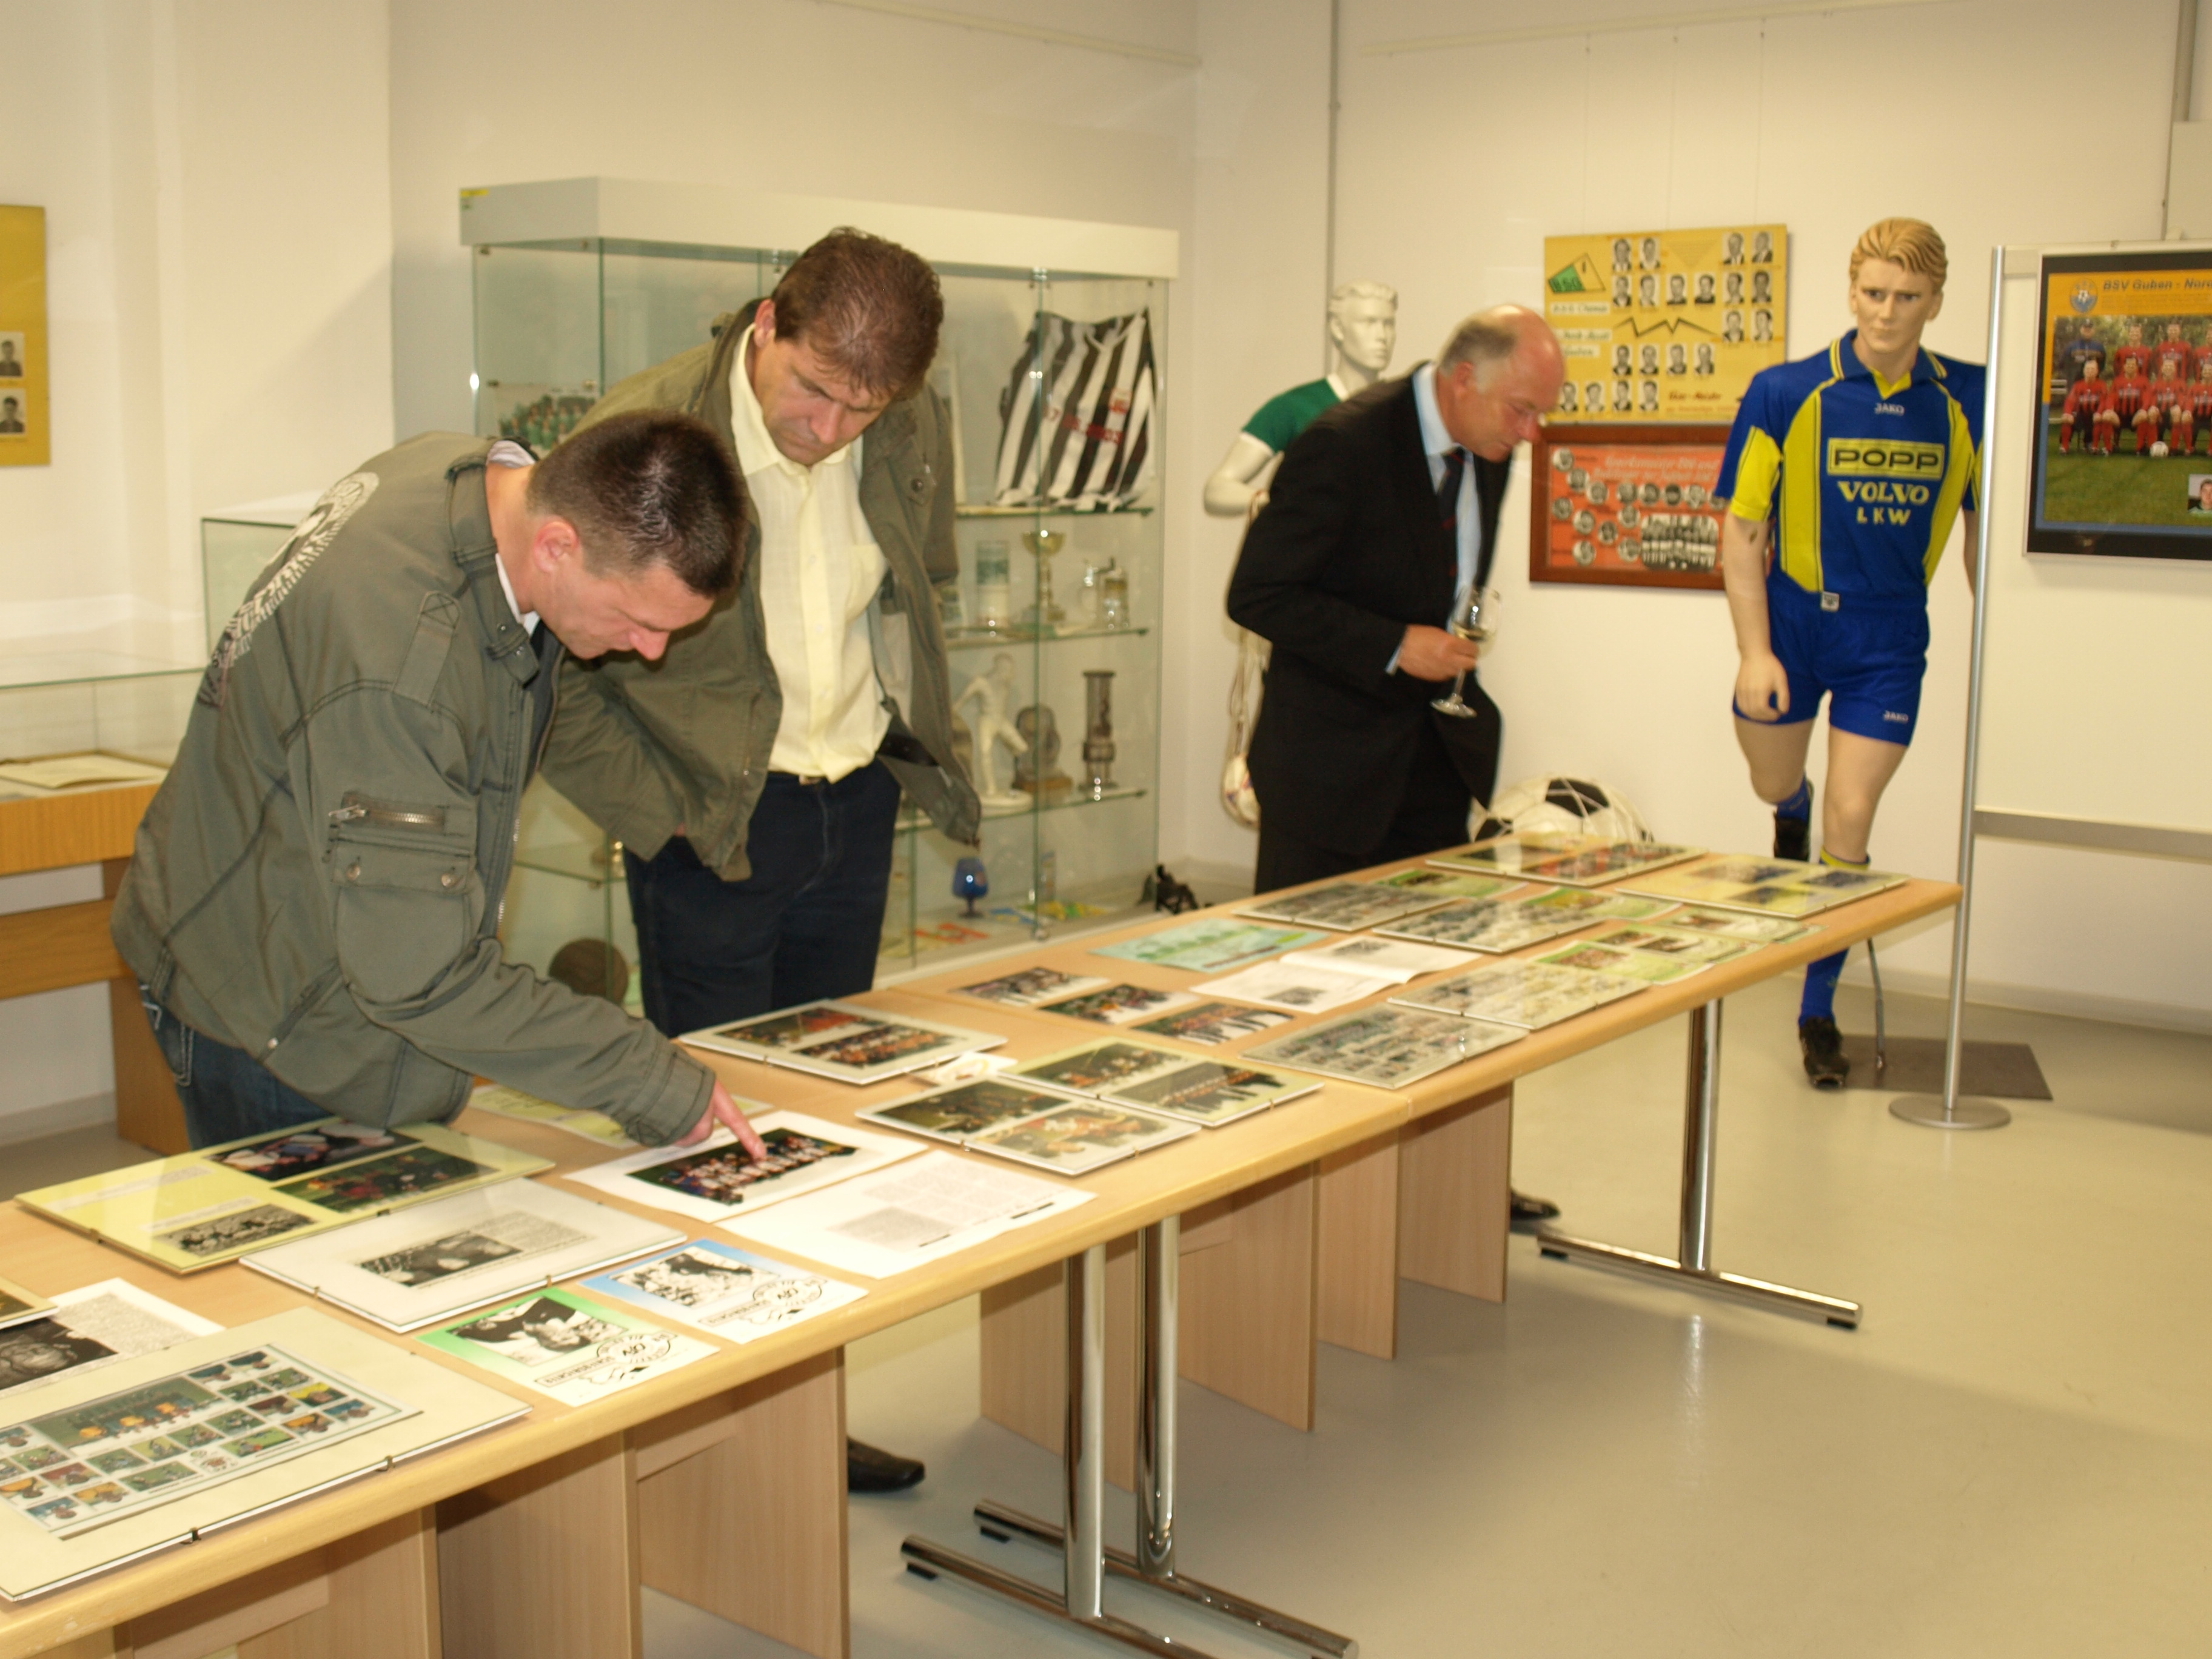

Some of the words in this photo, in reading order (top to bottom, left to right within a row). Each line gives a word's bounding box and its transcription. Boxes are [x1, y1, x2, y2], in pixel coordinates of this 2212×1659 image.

[2103, 280, 2130, 292] BSV
[1875, 403, 1905, 416] JAKO
[1835, 449, 1939, 469] POPP
[1837, 481, 1930, 505] VOLVO
